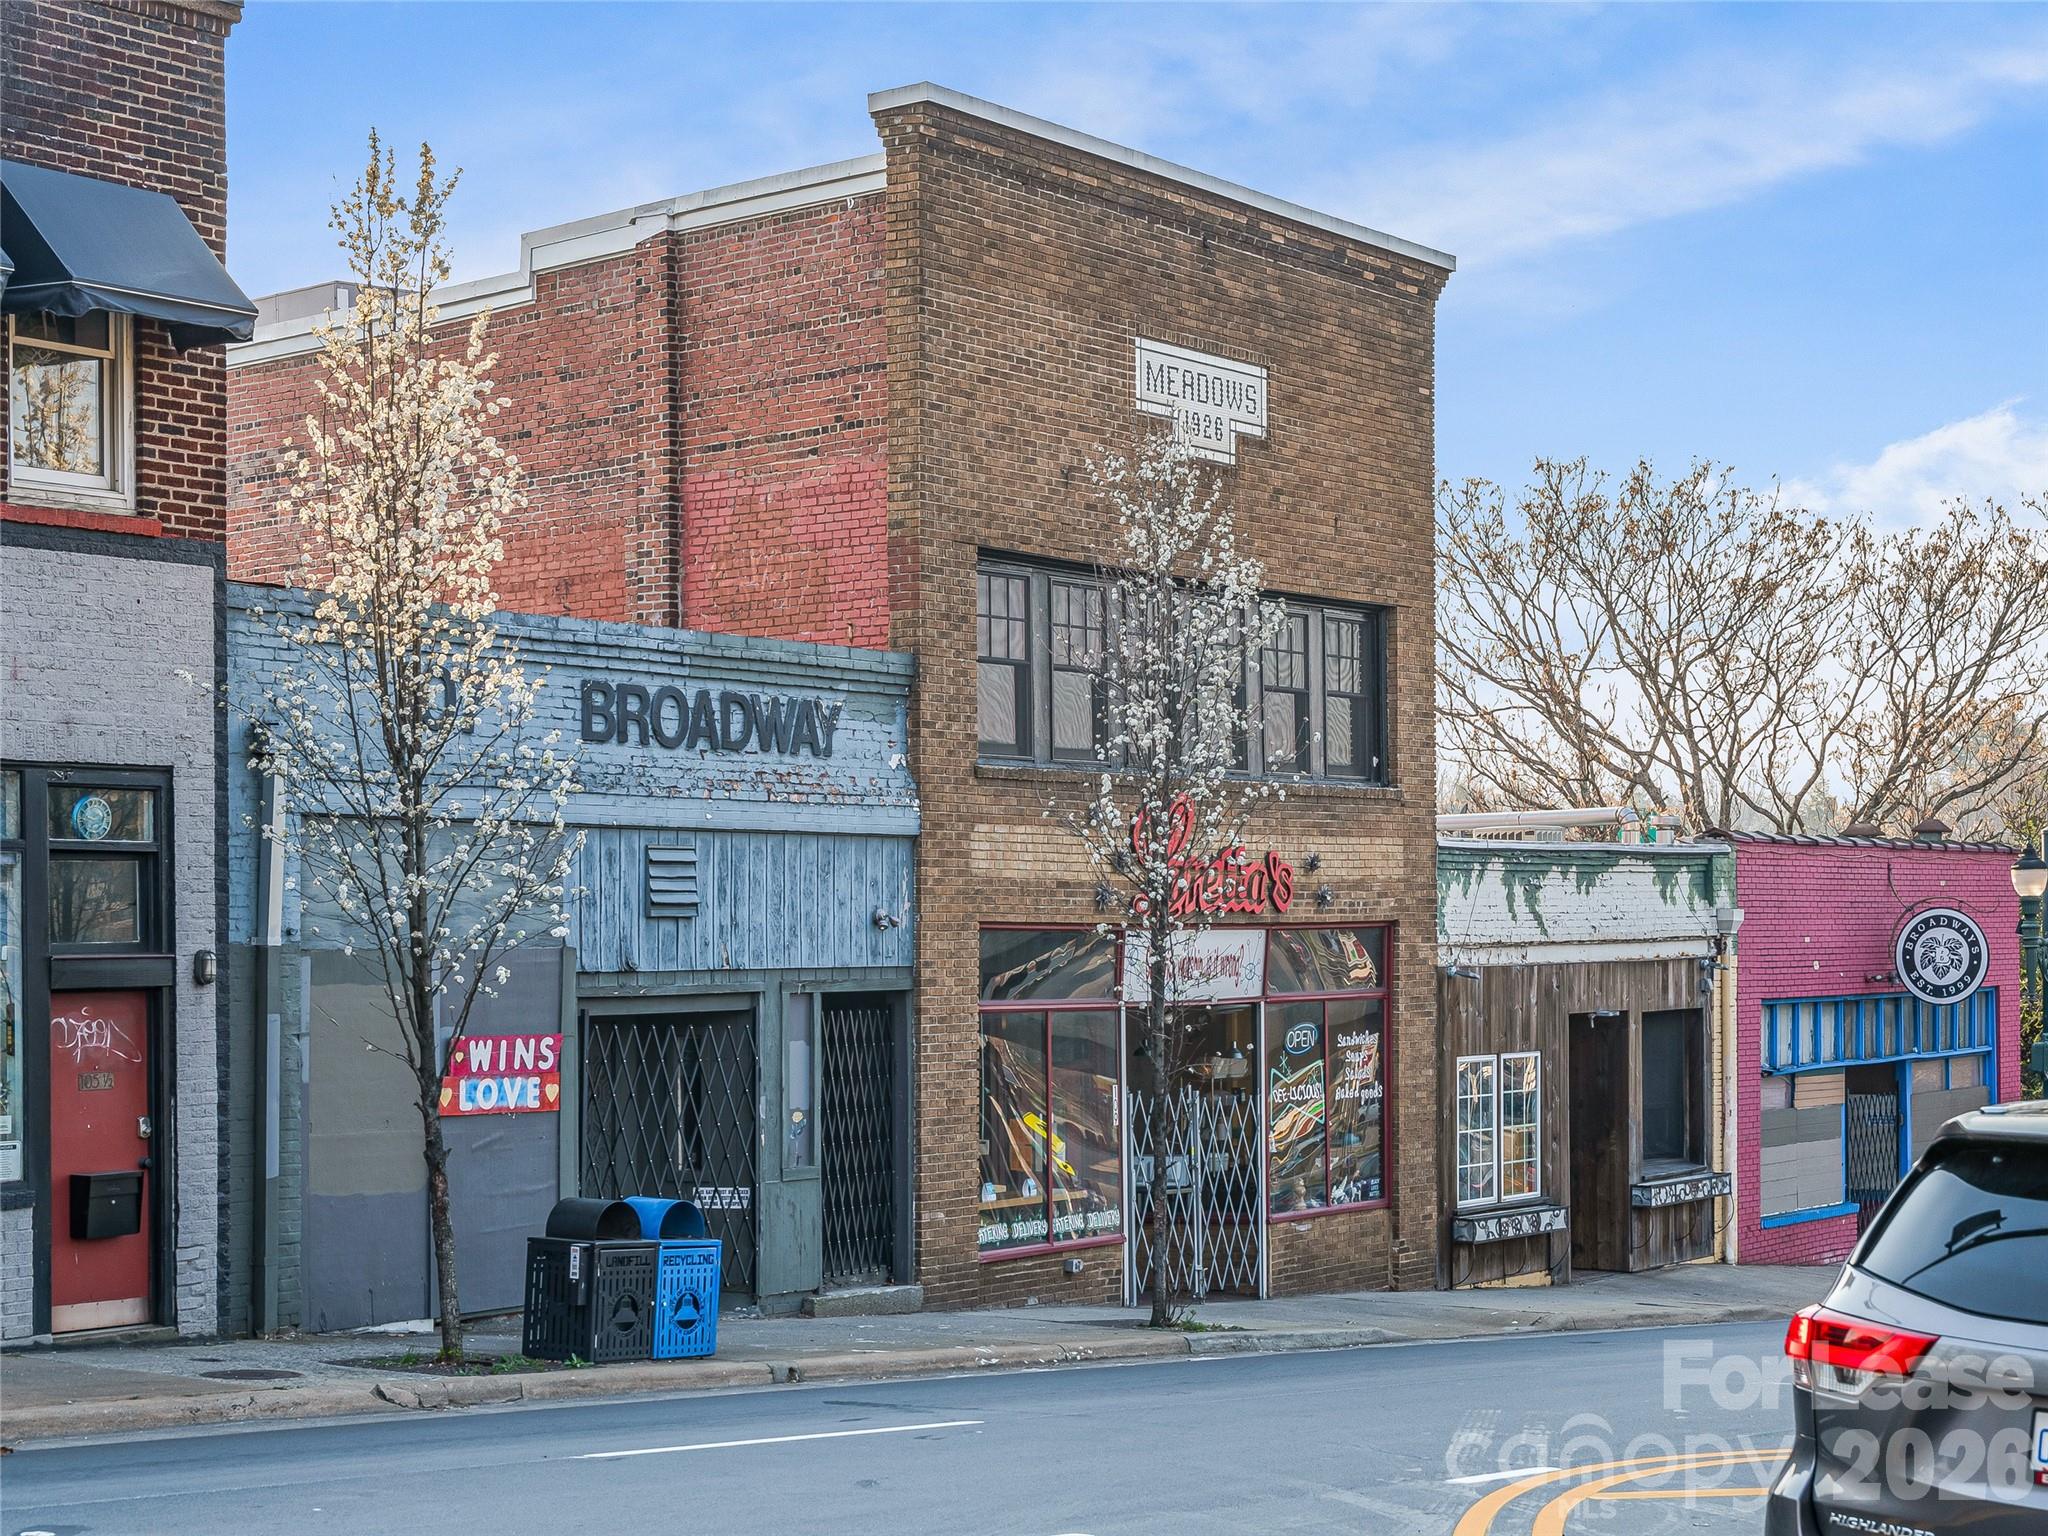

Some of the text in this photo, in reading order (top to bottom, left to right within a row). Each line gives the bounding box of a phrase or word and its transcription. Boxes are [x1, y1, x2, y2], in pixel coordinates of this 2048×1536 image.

[1184, 410, 1223, 441] 1926
[580, 678, 843, 757] BROADWAY
[1905, 917, 1980, 954] BROADWAYS
[1910, 971, 1971, 997] EST. 1999
[1287, 1030, 1315, 1048] OPEN
[1337, 1030, 1378, 1047] Sandwiches
[469, 1036, 554, 1072] WINS
[1345, 1050, 1368, 1062] Soups
[459, 1076, 540, 1111] LOVE
[605, 1254, 651, 1268] LANDFILL
[663, 1253, 714, 1267] RECYCLING
